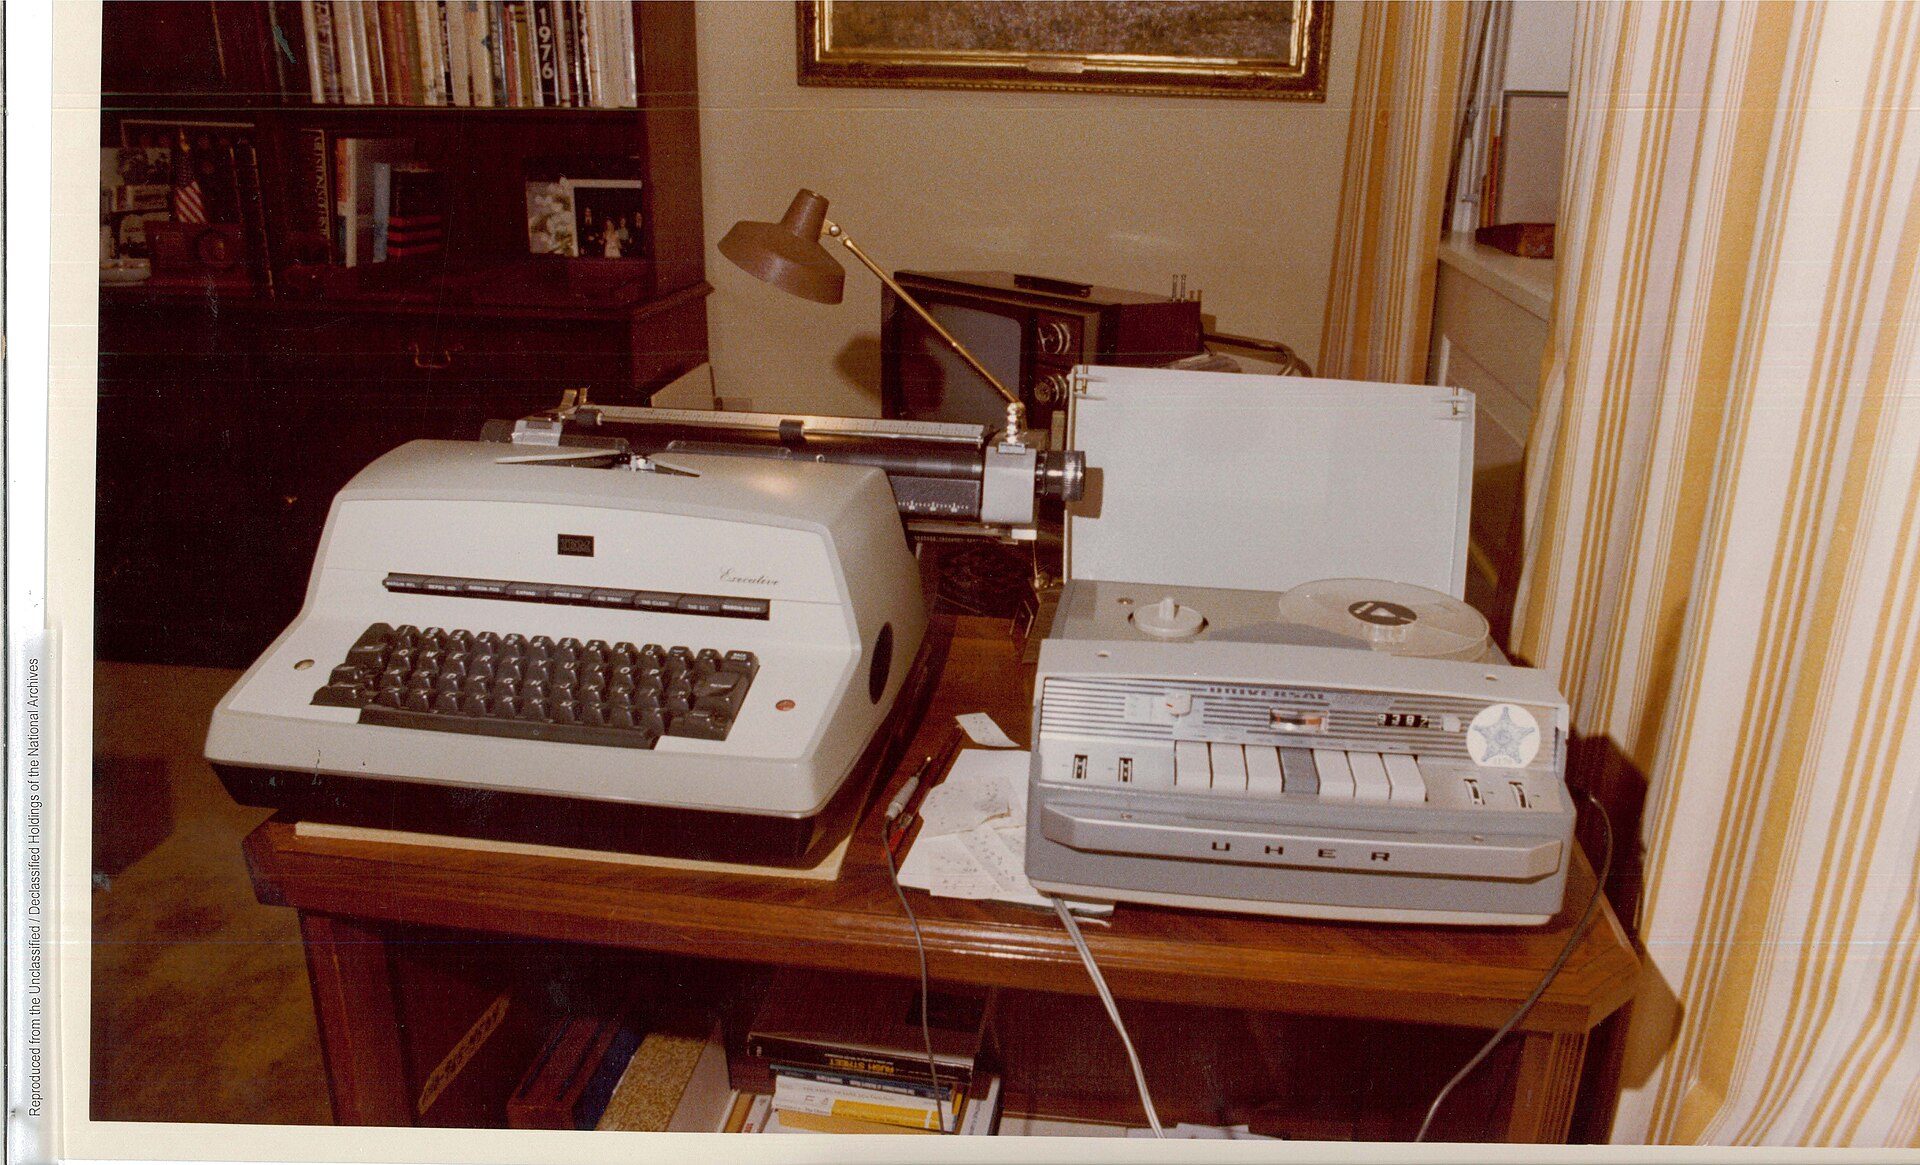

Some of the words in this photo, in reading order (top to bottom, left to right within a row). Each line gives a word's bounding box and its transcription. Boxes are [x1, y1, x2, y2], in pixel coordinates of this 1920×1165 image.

[538, 7, 555, 80] 1976
[719, 567, 780, 586] Executive
[1210, 839, 1391, 862] UHER
[829, 1057, 866, 1070] STREET
